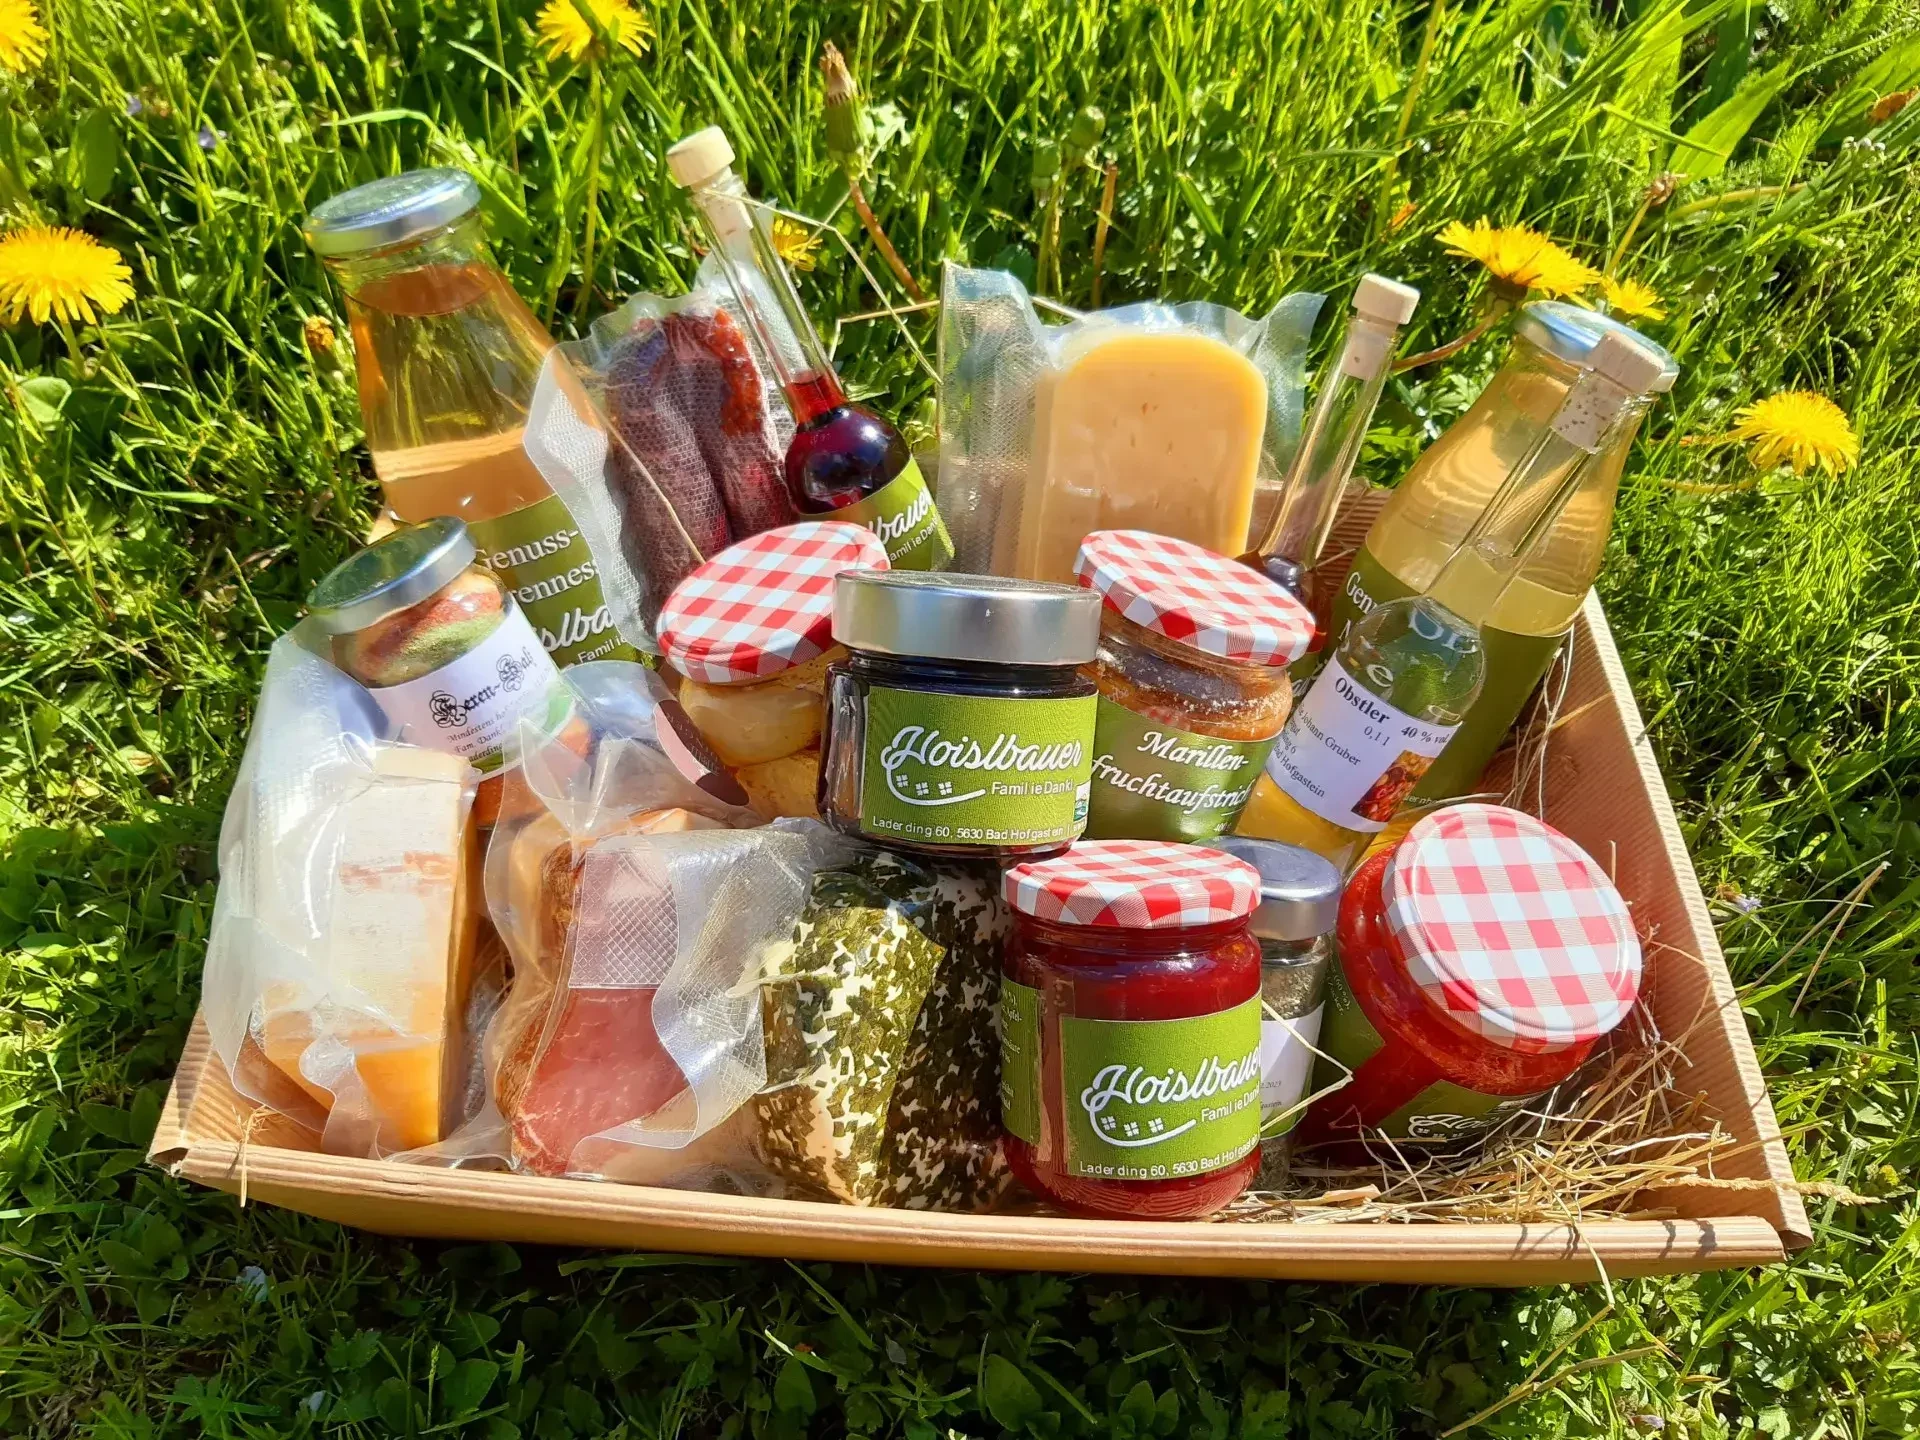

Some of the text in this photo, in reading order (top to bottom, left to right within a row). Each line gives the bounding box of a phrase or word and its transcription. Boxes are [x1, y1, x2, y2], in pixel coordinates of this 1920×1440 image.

[887, 537, 922, 563] amilie
[508, 560, 600, 604] ennes
[1335, 677, 1390, 724] Obstler
[1137, 731, 1249, 771] Marillen-
[1301, 711, 1325, 741] Johann
[1324, 735, 1361, 766] Gruber
[1401, 726, 1418, 739] 40
[1280, 754, 1326, 798] Hofgastein
[956, 827, 983, 840] 5630
[986, 828, 1008, 840] Bad
[1150, 1165, 1170, 1178] 60,
[1172, 1161, 1199, 1175] 5630
[1200, 1153, 1220, 1170] Bad
